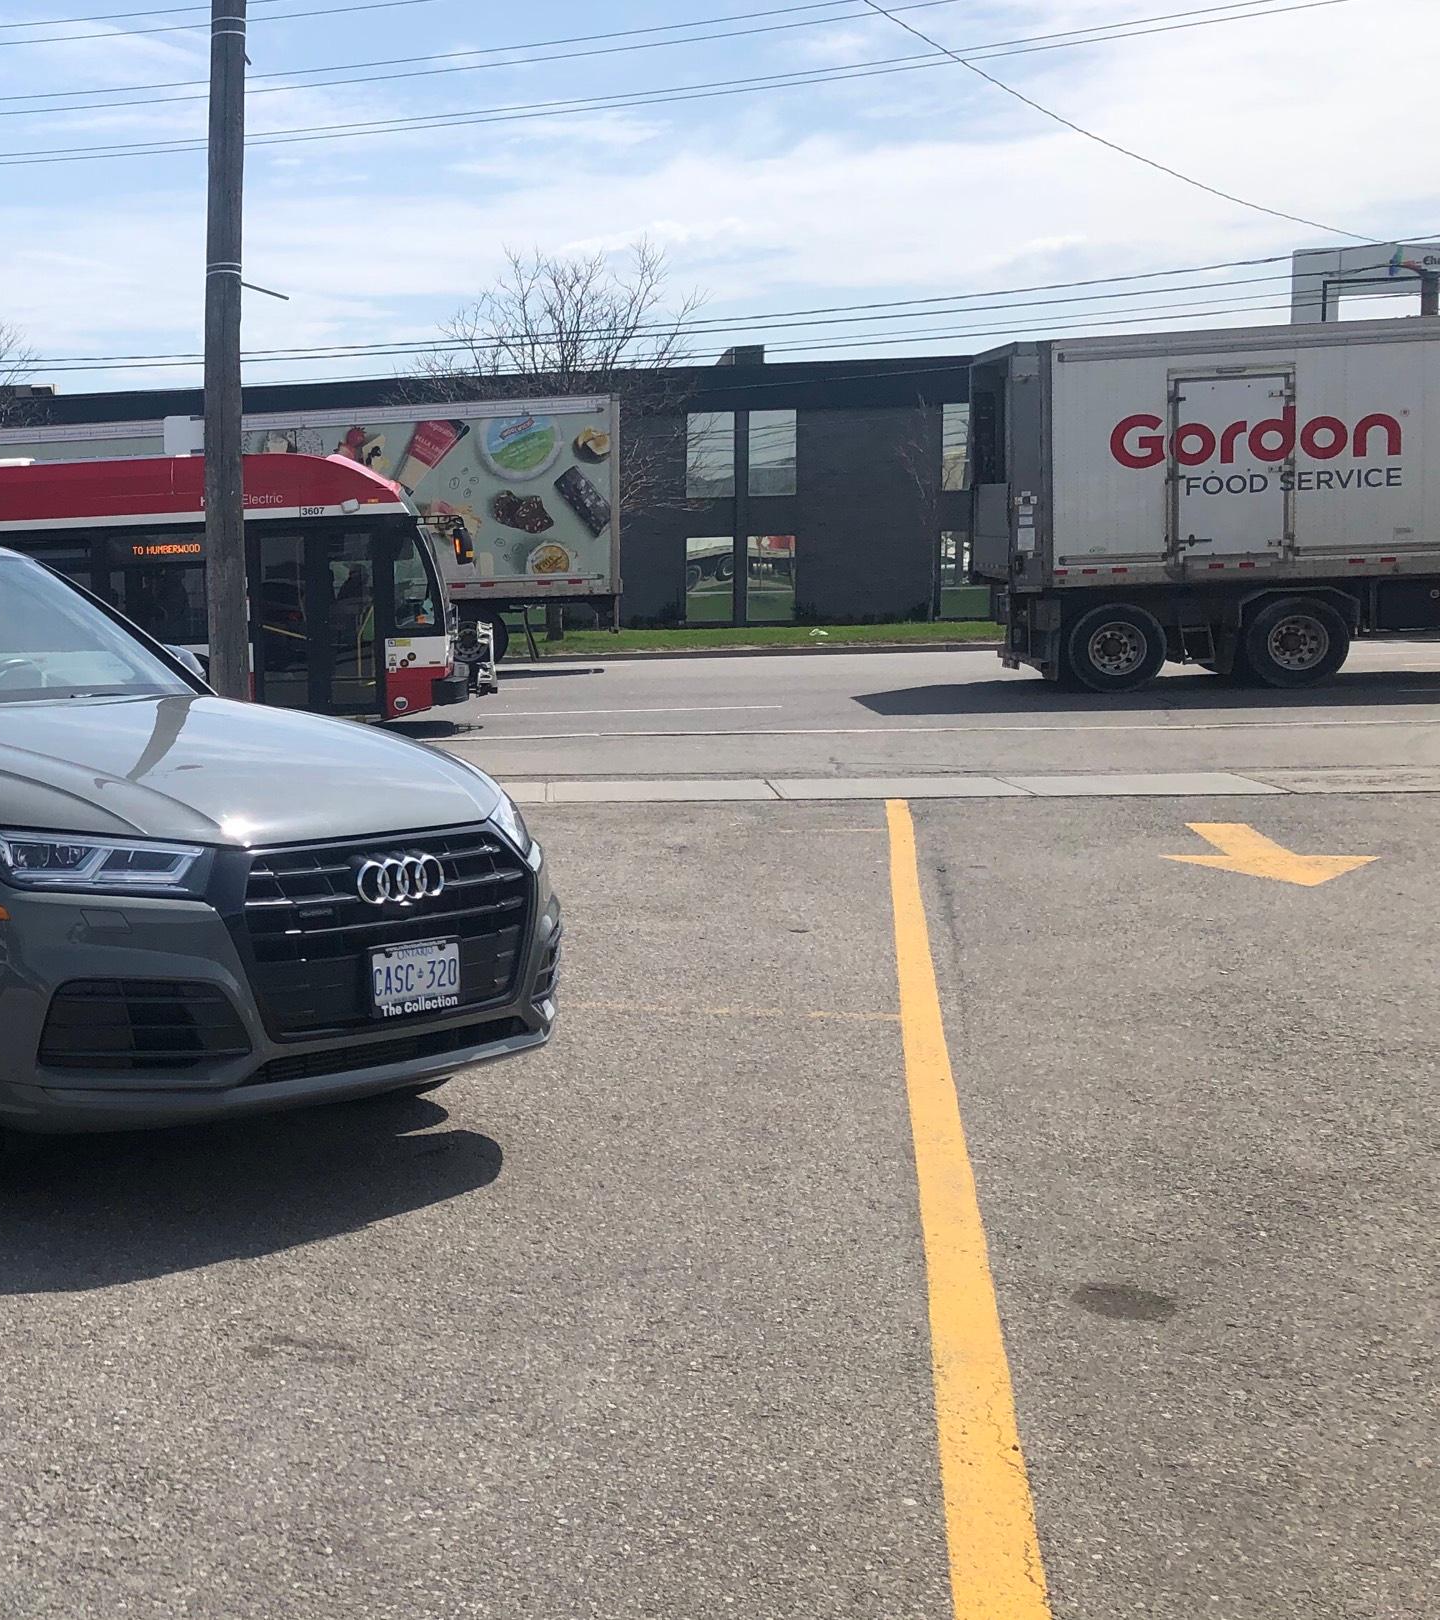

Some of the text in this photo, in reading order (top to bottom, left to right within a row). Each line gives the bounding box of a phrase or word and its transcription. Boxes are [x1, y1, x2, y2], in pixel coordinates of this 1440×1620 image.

[1110, 405, 1402, 469] Gordon
[1185, 467, 1402, 496] FOOD SERVICE
[242, 493, 284, 505] Electric
[302, 507, 325, 516] 3607
[132, 544, 201, 555] TO HUMBERWOOD
[374, 957, 457, 997] CASC 320
[381, 1001, 402, 1017] The
[404, 995, 459, 1013] Collection
